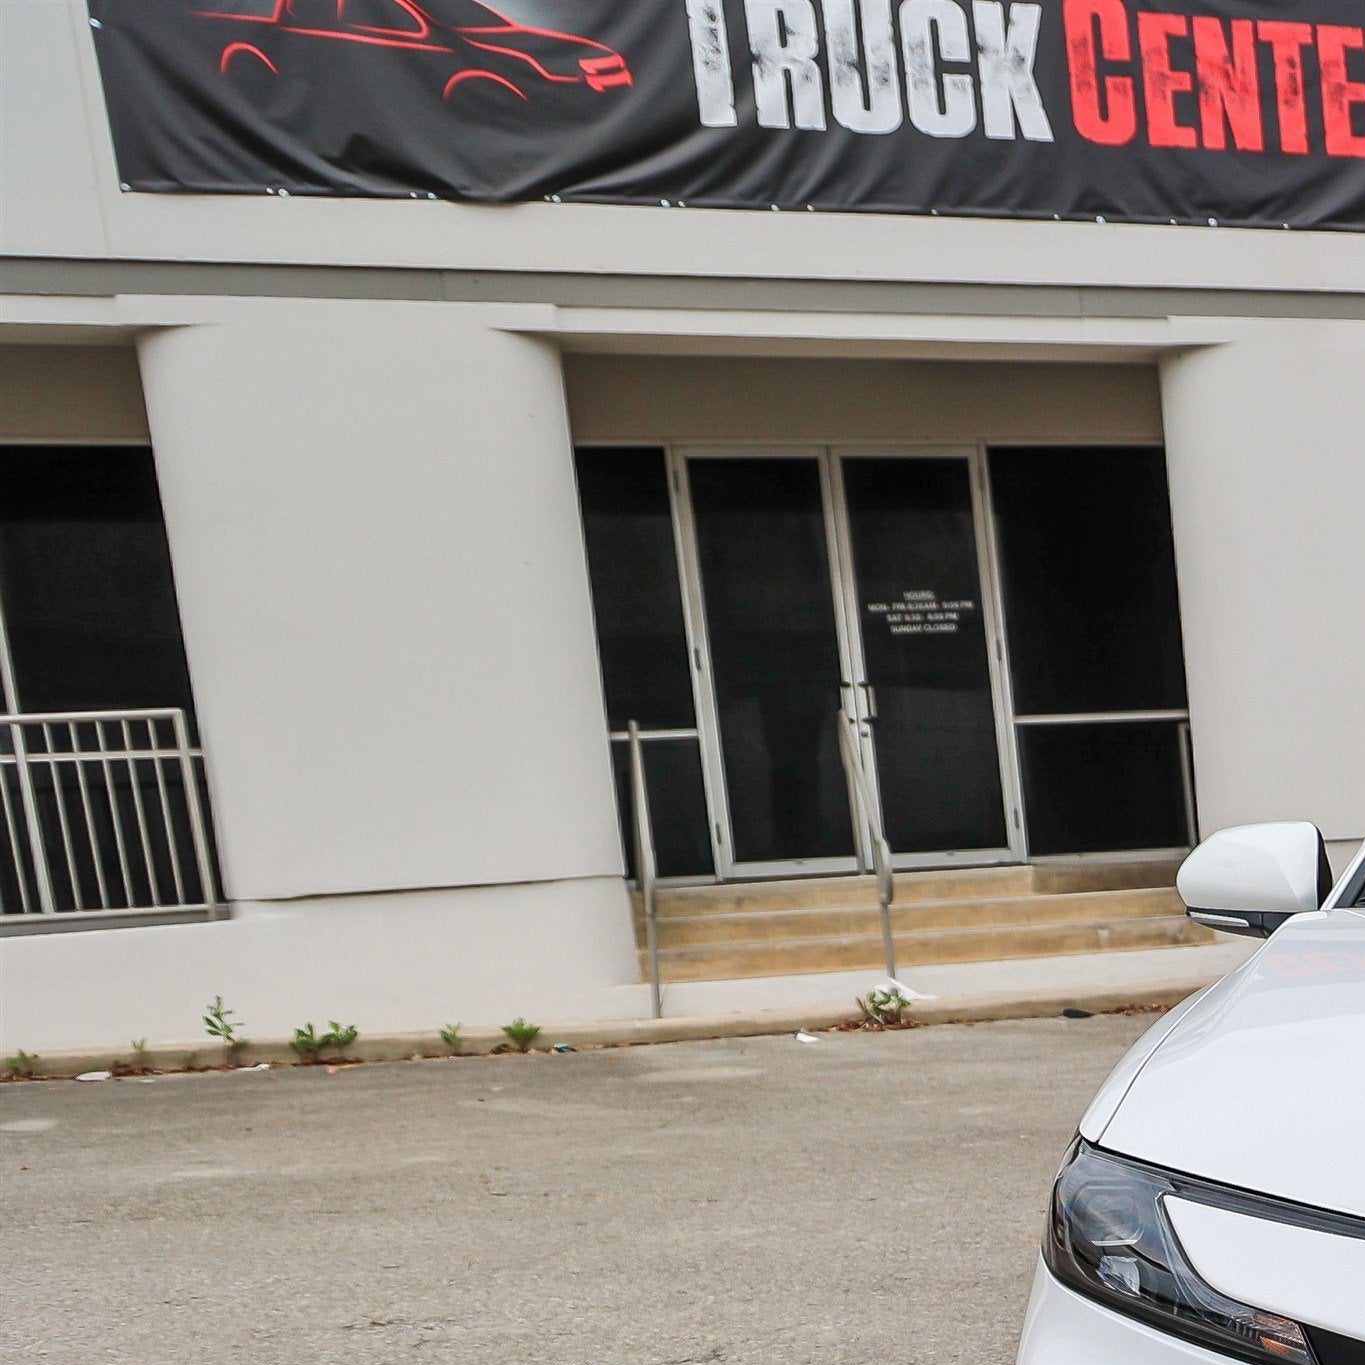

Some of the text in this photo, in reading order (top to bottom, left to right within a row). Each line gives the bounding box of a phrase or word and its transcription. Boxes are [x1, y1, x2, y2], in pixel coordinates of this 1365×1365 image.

[685, 0, 1054, 142] TRUCK
[890, 622, 957, 633] SUNDAY CLOSED
